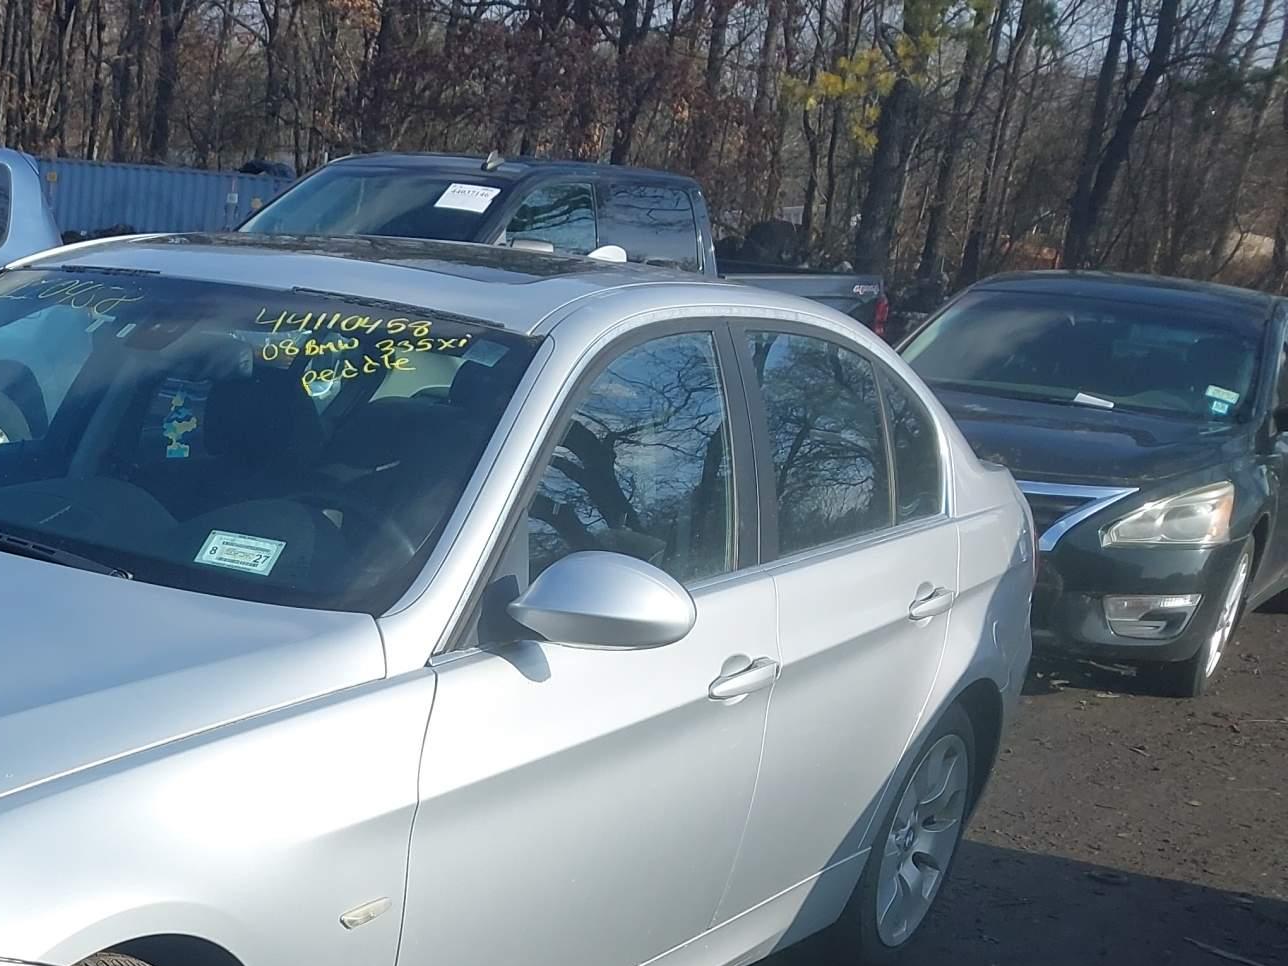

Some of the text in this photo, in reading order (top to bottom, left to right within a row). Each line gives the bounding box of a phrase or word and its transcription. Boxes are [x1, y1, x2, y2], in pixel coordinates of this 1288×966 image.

[255, 308, 432, 337] 44110458
[262, 338, 299, 361] 08
[305, 338, 359, 356] BMW
[209, 545, 218, 555] 8
[252, 553, 271, 564] 27
